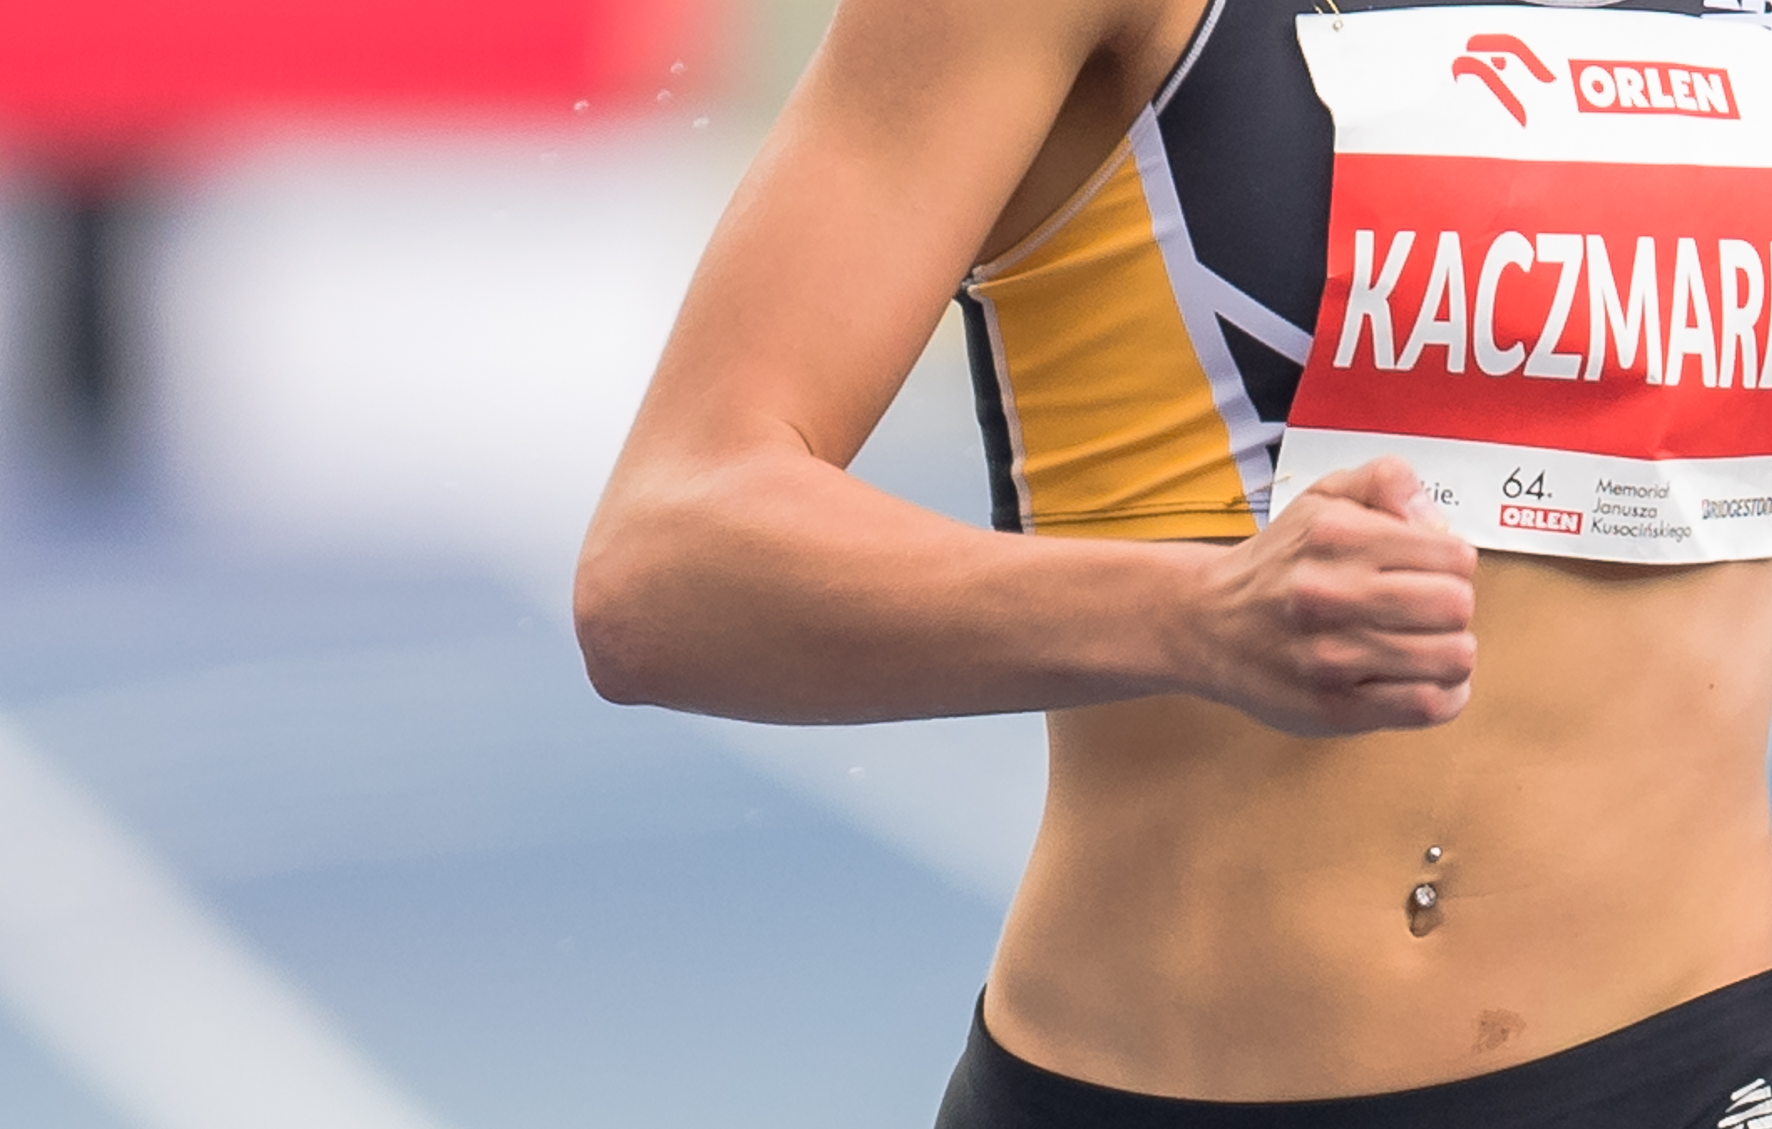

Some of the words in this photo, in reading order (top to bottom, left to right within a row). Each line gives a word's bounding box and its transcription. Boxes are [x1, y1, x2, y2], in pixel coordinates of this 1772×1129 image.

[1579, 65, 1730, 114] ORLEN
[1502, 467, 1552, 500] 64.
[1595, 478, 1671, 499] Memorial
[1502, 506, 1579, 531] ORLEN
[1592, 497, 1658, 519] Janusza
[1590, 517, 1692, 543] Kusocińskiego
